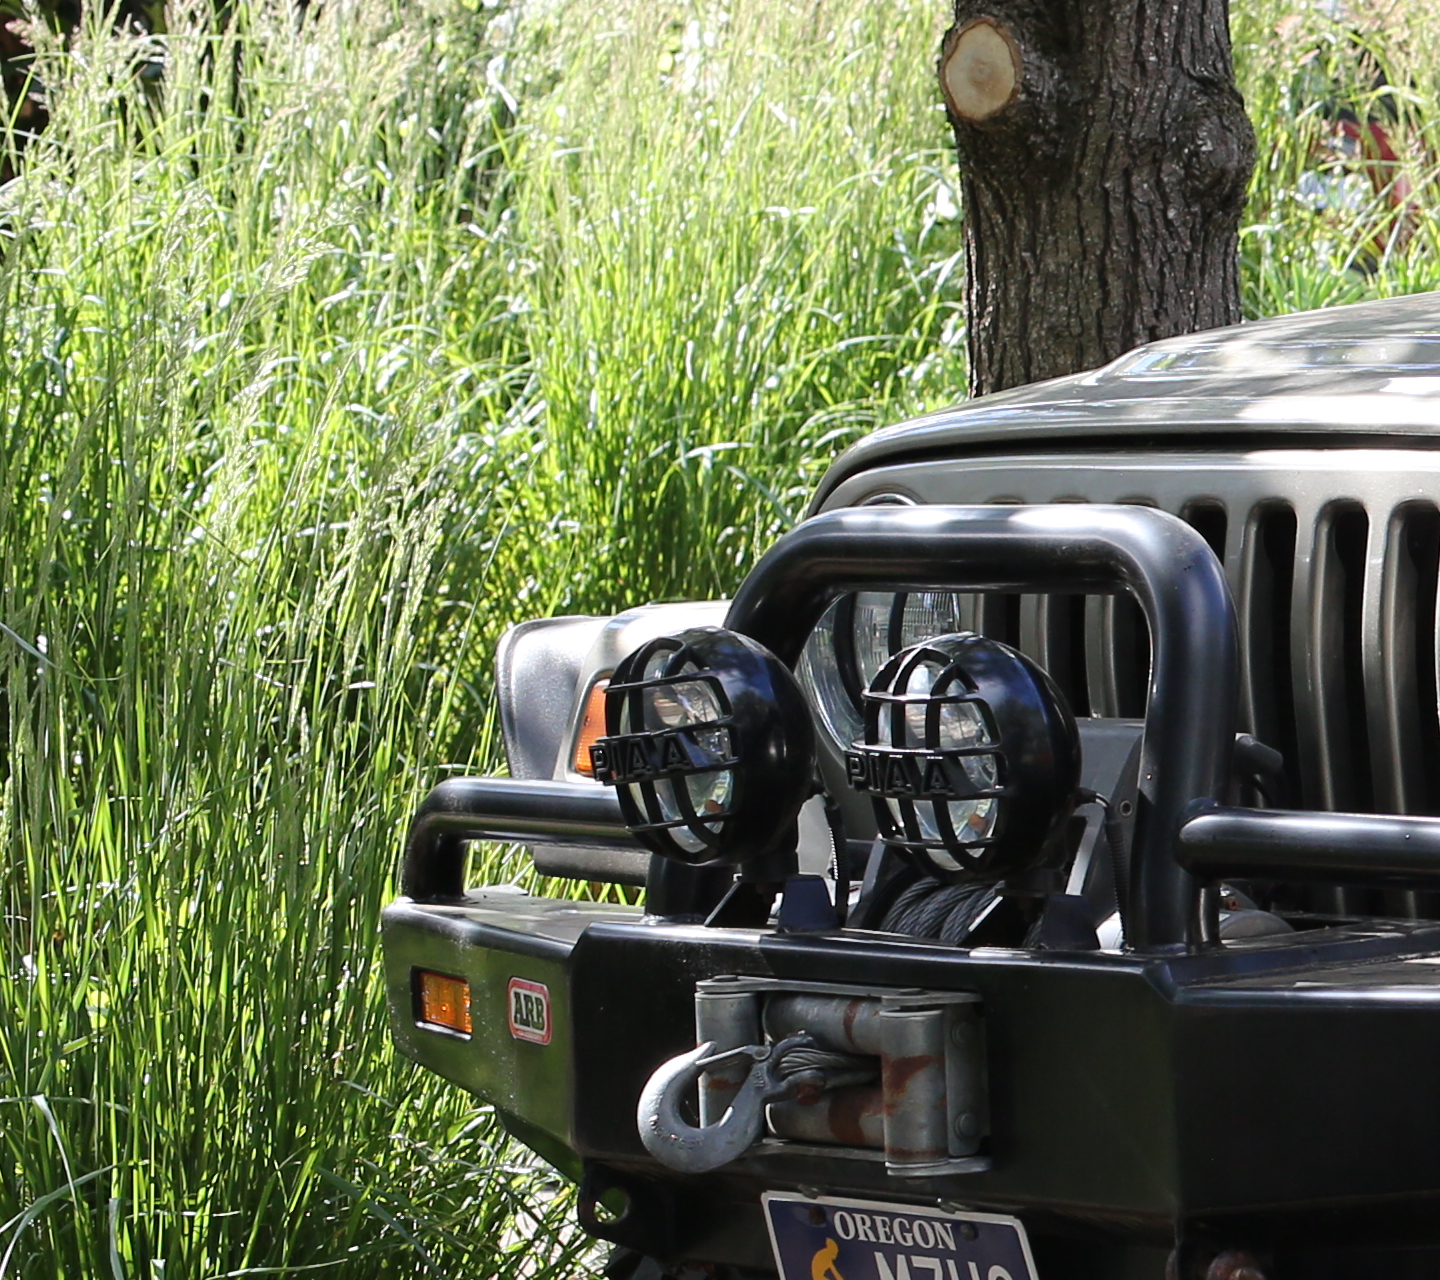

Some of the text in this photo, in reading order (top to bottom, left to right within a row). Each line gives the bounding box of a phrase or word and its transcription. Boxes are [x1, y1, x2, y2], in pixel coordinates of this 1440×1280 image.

[589, 733, 695, 783] PIAA
[845, 749, 953, 795] PIAA
[513, 990, 545, 1032] ARB
[833, 1210, 957, 1251] OREGON
